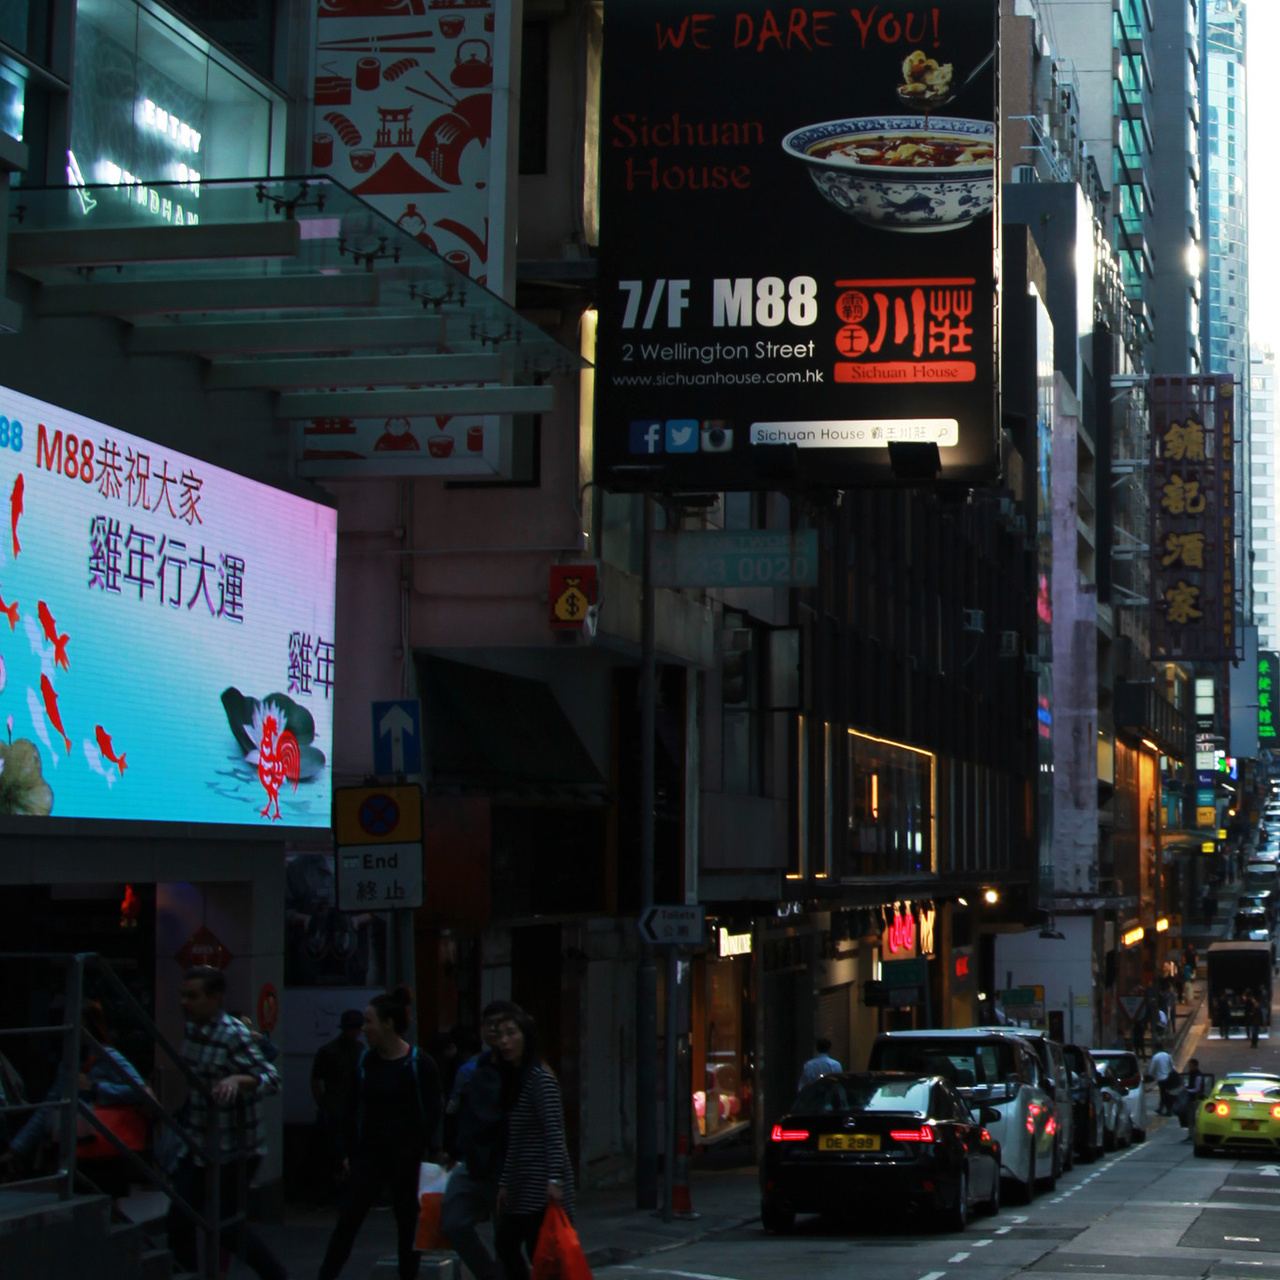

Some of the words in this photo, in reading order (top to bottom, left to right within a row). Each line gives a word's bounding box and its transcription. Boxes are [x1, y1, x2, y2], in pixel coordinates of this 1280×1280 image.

[656, 13, 716, 52] WE
[733, 7, 838, 53] DARE
[850, 4, 941, 50] YOU!
[611, 113, 764, 148] Sichuan
[624, 156, 752, 192] House
[618, 278, 690, 330] 7/F
[713, 275, 818, 328] M88
[621, 344, 635, 361] 2
[641, 342, 749, 364] Wellington
[754, 340, 815, 359] Street
[611, 369, 825, 387] www.sichuanhouse.com.hk
[851, 365, 907, 380] Sichuan
[913, 364, 959, 379] House
[757, 427, 817, 441] Sichuan
[821, 427, 866, 440] House
[1161, 417, 1206, 625] 鏞記酒家
[88, 515, 246, 624] 雞年行大運
[363, 853, 399, 870] End
[356, 880, 405, 902] 終止
[661, 909, 696, 920] Toilets
[848, 1137, 874, 1149] 299
